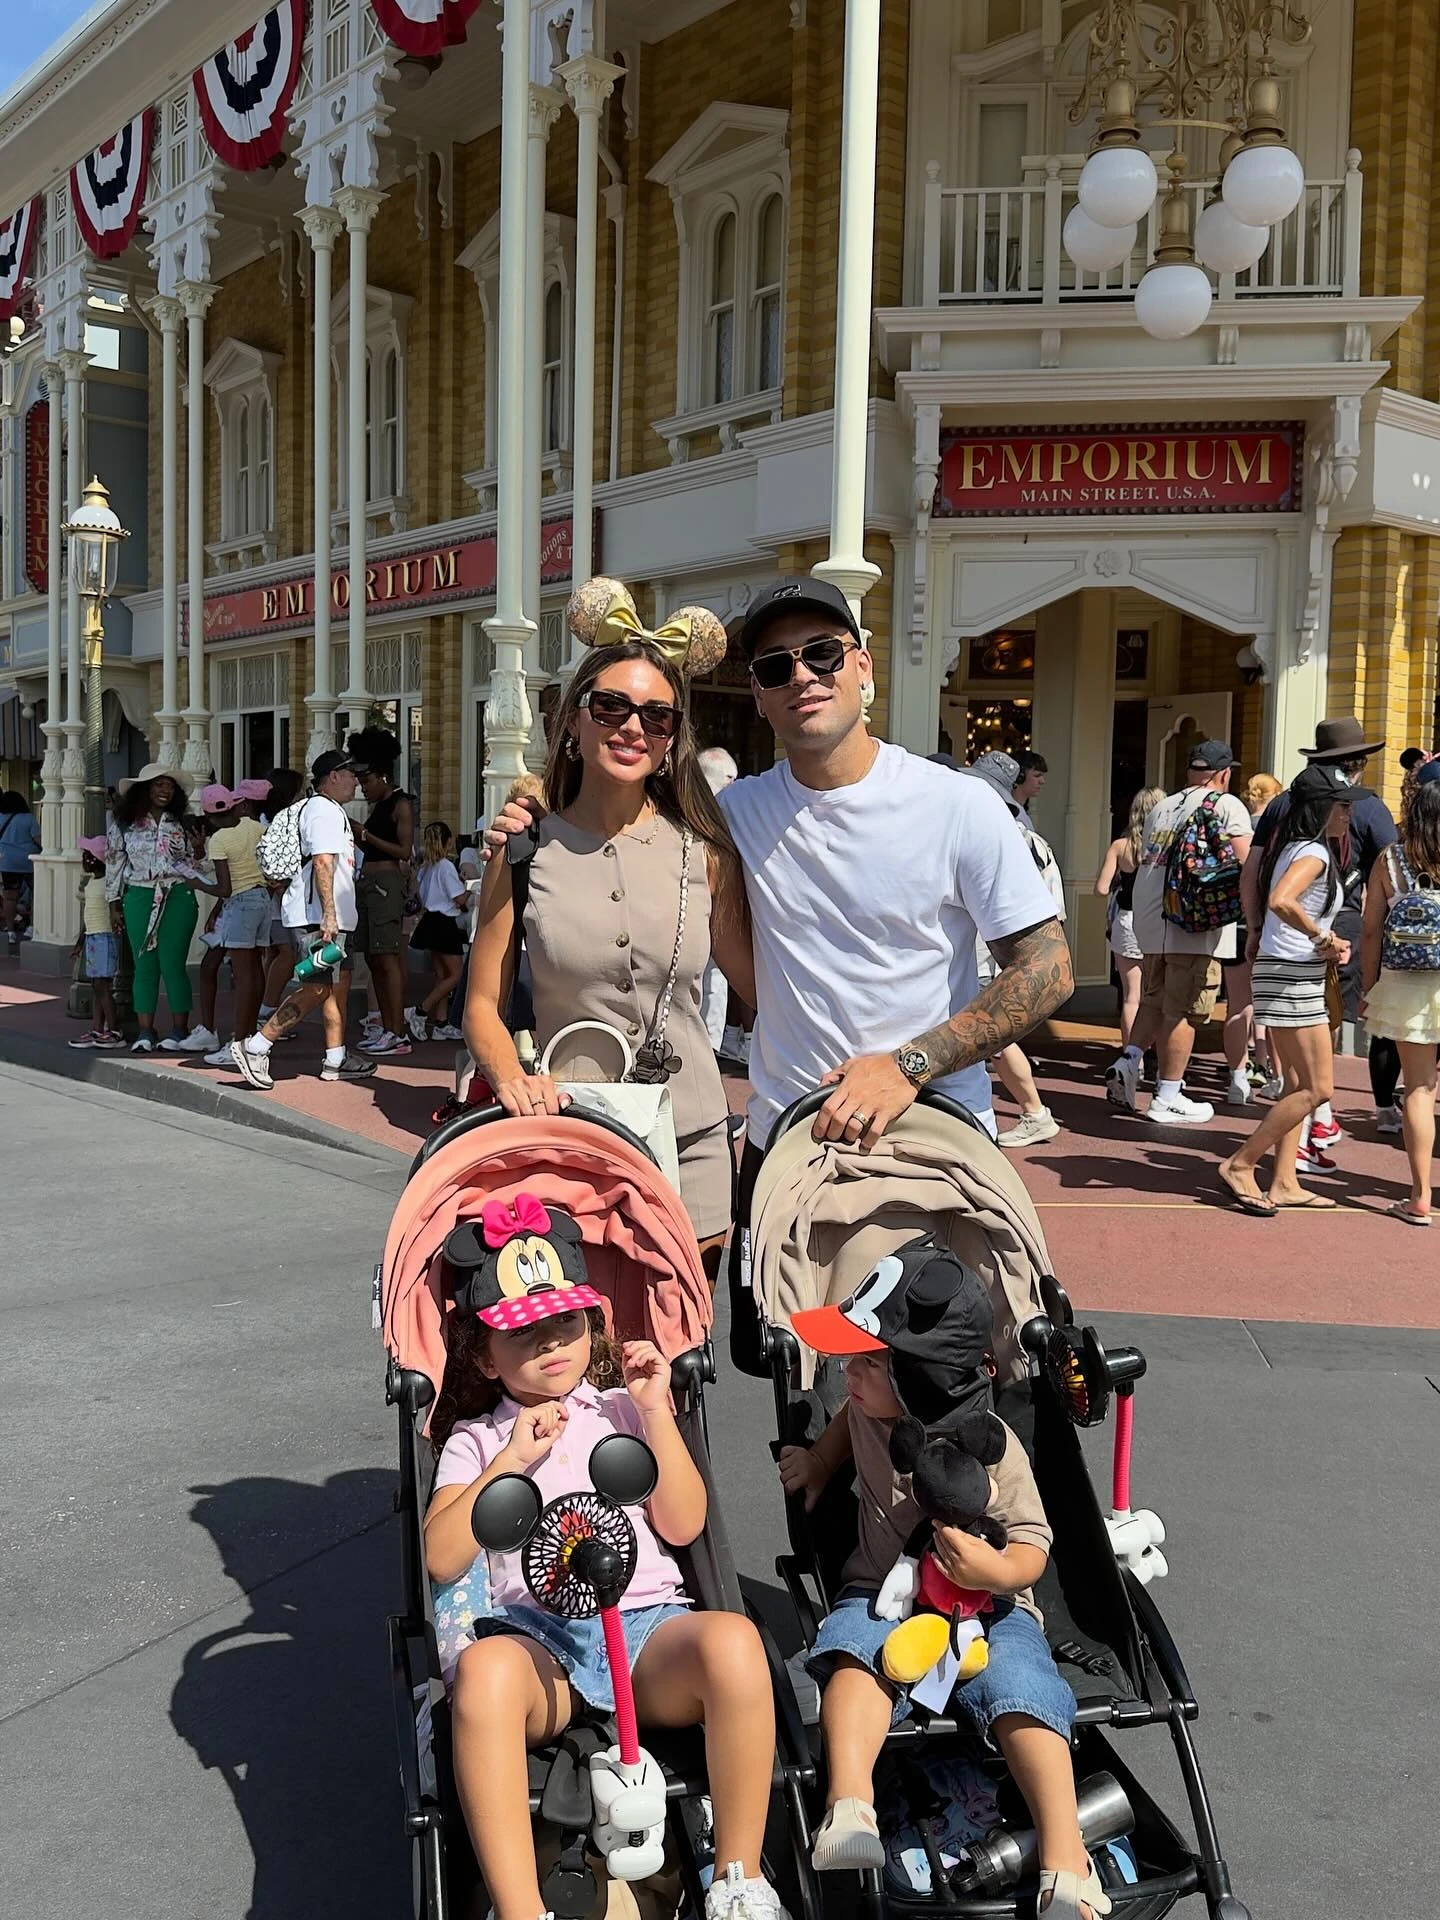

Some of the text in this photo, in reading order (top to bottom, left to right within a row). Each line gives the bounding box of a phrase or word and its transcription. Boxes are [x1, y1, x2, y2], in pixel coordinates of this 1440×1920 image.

[958, 438, 1273, 490] EMPORIUM
[1020, 488, 1073, 502] MAIN
[1166, 485, 1217, 500] U.S.A.
[539, 529, 567, 562] otions
[261, 549, 463, 622] EMORIUM
